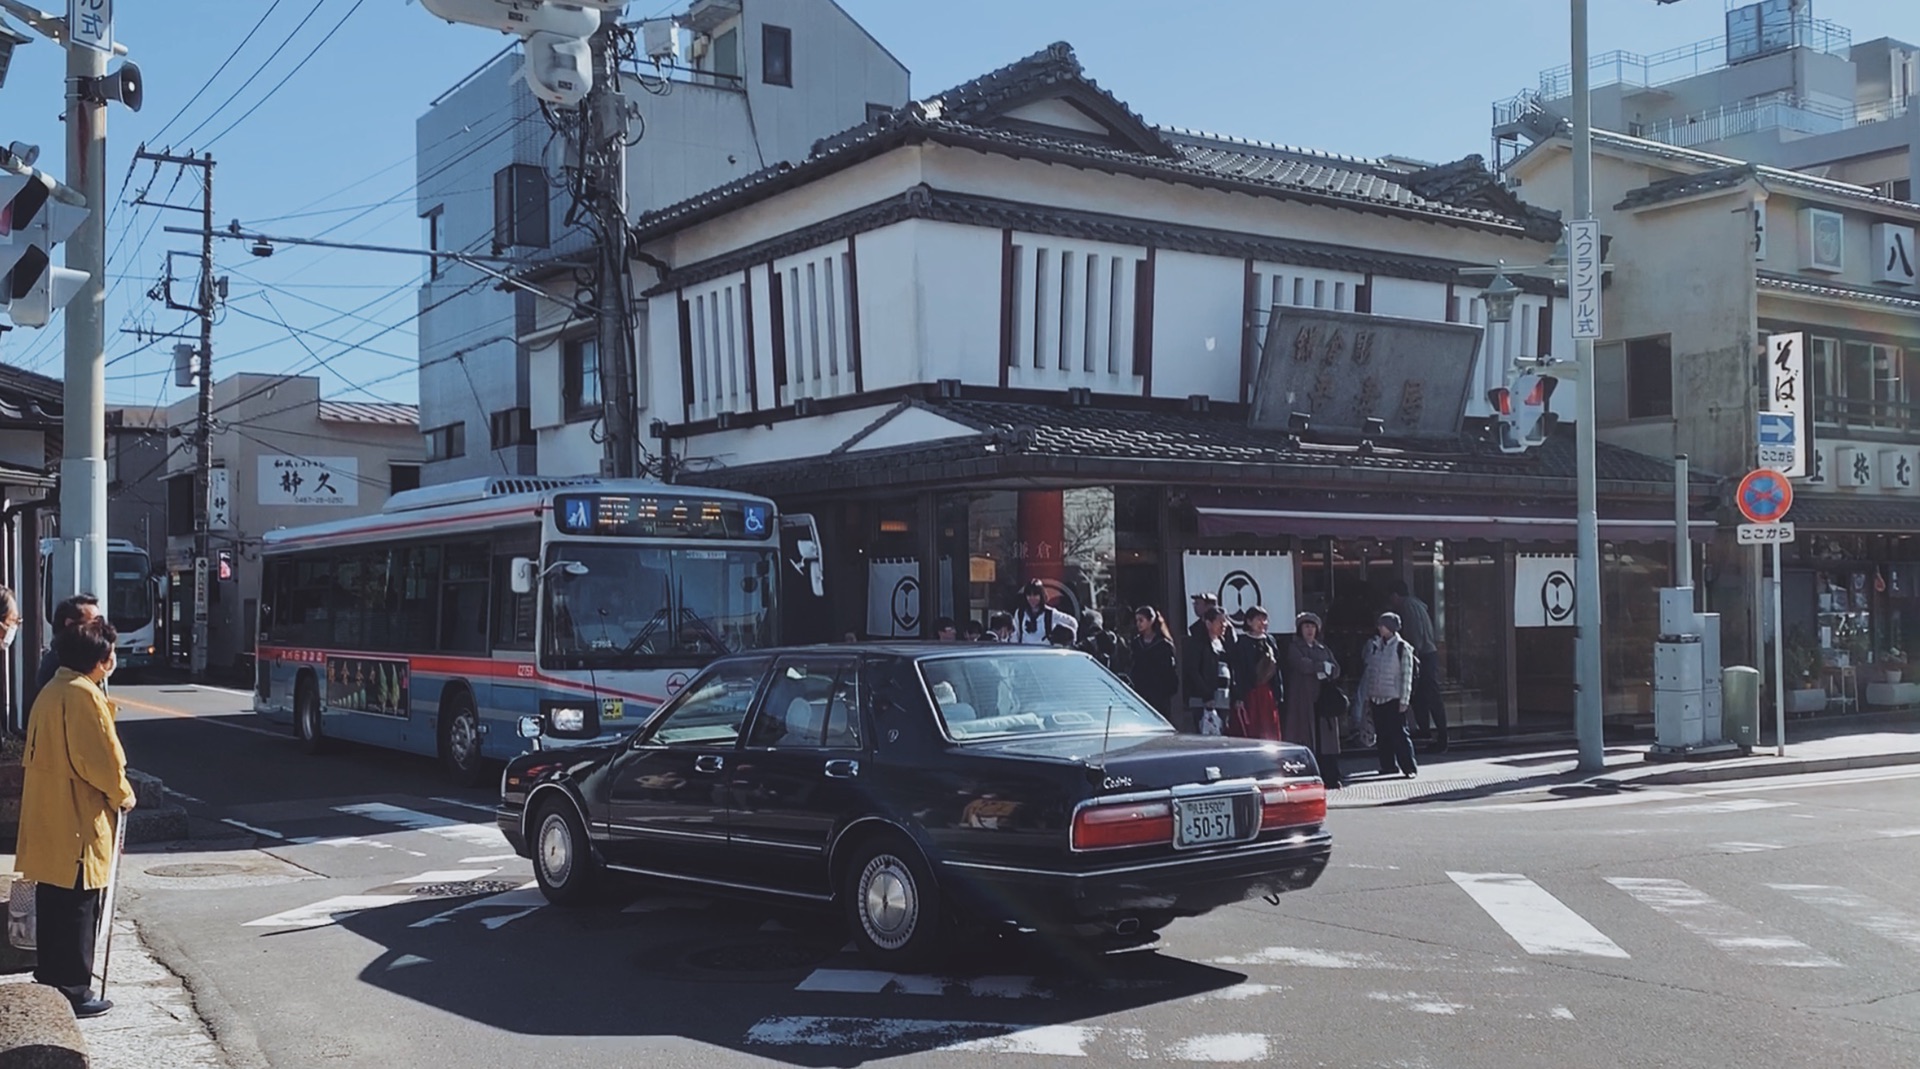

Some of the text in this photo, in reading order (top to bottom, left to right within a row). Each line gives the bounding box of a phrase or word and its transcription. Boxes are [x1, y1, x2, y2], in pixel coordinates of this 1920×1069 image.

[1576, 227, 1594, 333] スクランブル式
[1761, 450, 1794, 462] ここから
[279, 470, 337, 496] 静久
[1741, 526, 1791, 540] ここから
